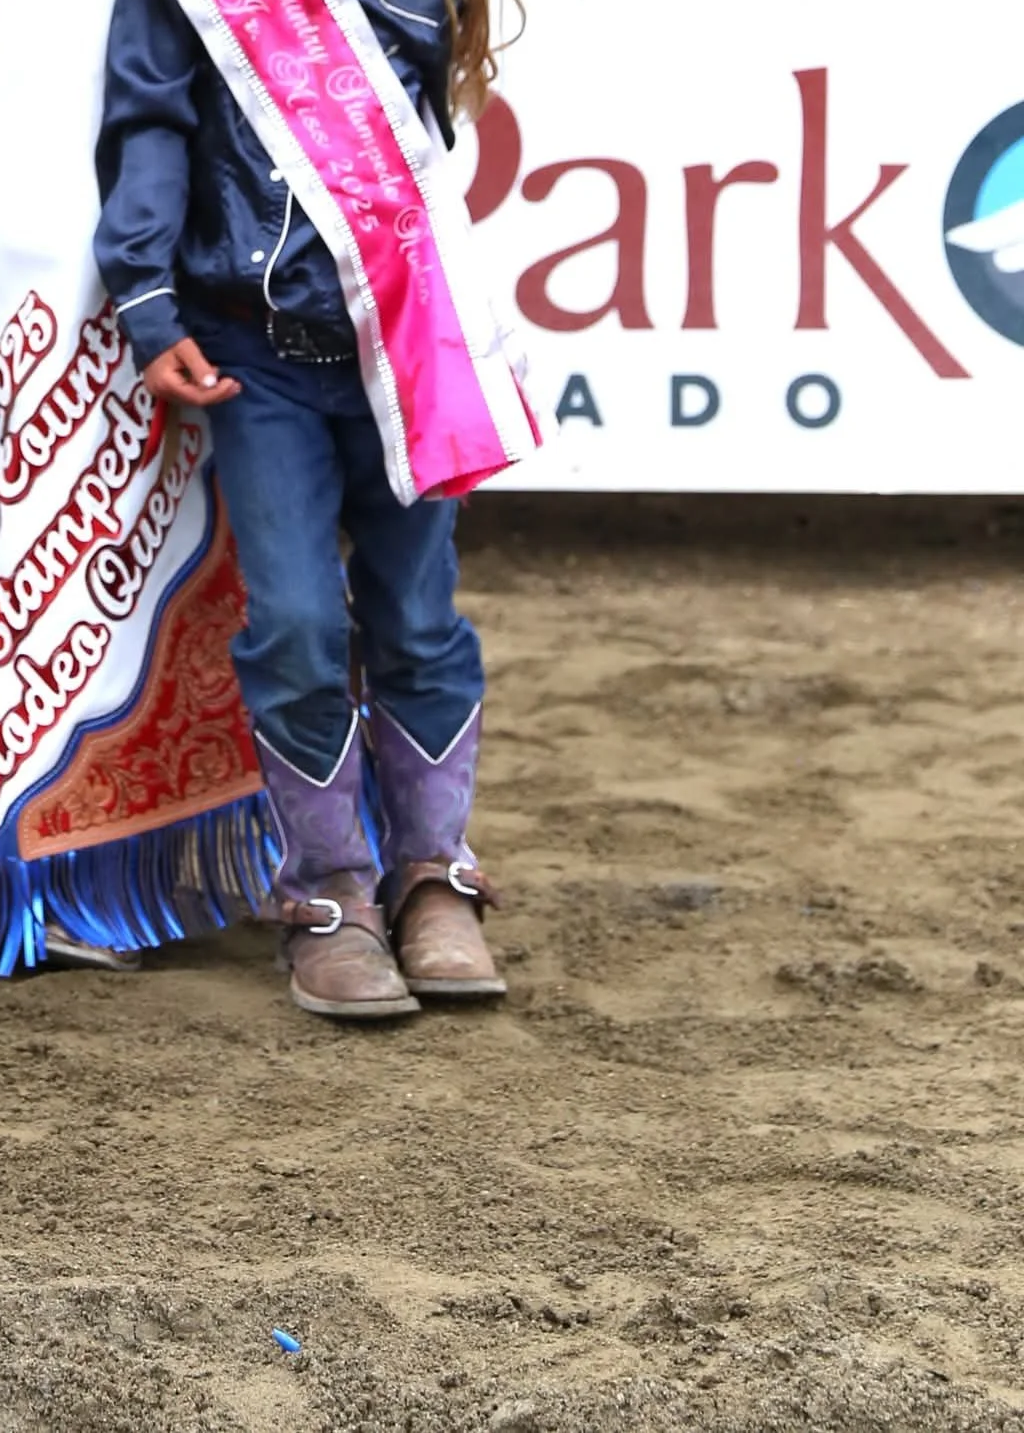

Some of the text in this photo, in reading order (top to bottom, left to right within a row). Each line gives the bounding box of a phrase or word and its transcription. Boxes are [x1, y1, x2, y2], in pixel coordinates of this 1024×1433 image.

[325, 64, 401, 202] Stampede
[326, 159, 382, 235] 2025
[86, 424, 201, 622] Queen
